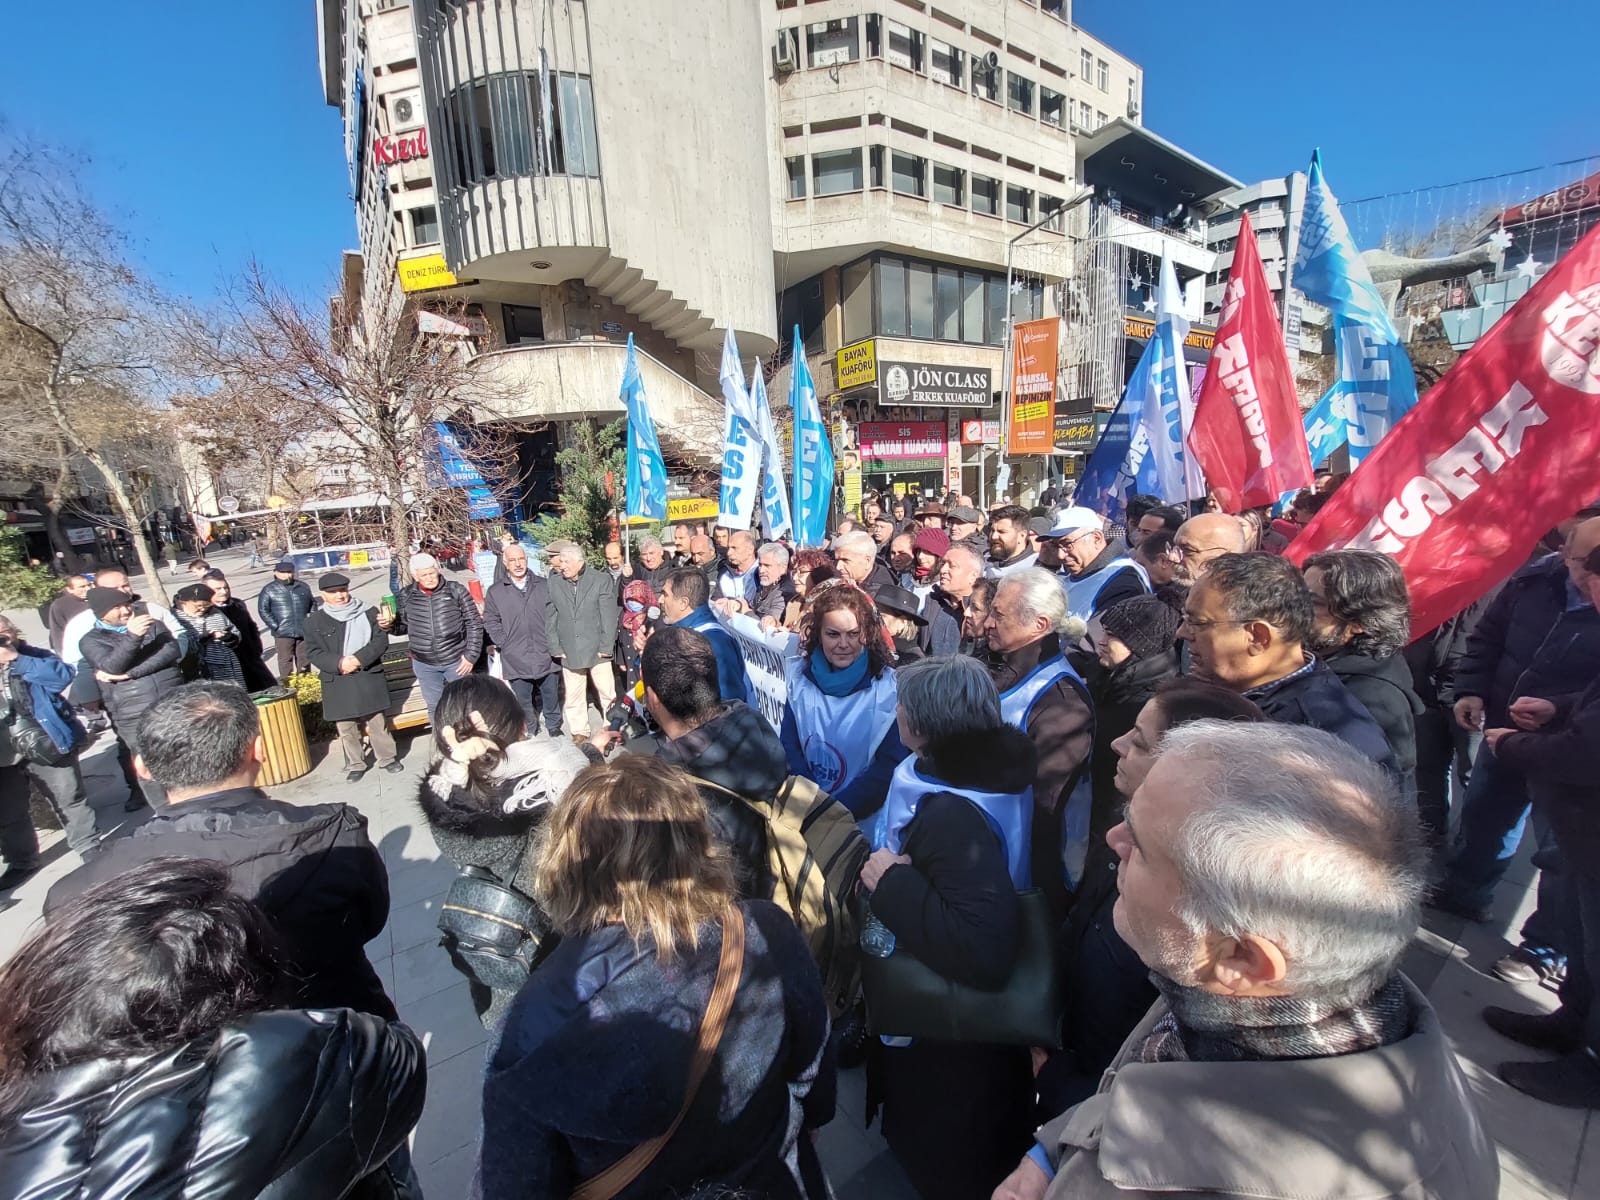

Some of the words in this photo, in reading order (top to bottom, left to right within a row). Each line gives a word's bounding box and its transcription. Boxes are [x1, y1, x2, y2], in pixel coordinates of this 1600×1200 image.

[1124, 322, 1145, 338] GAME
[1186, 333, 1203, 348] ERNET
[844, 346, 867, 362] BAYAN
[840, 356, 873, 377] KUAFÖRÜ
[911, 366, 942, 390] JÖN
[944, 371, 988, 389] CLASS
[912, 391, 943, 402] ERKEK
[944, 391, 986, 404] KUAFÖRÜ
[719, 414, 750, 516] ESK
[669, 505, 680, 515] AN
[681, 503, 699, 514] BAR
